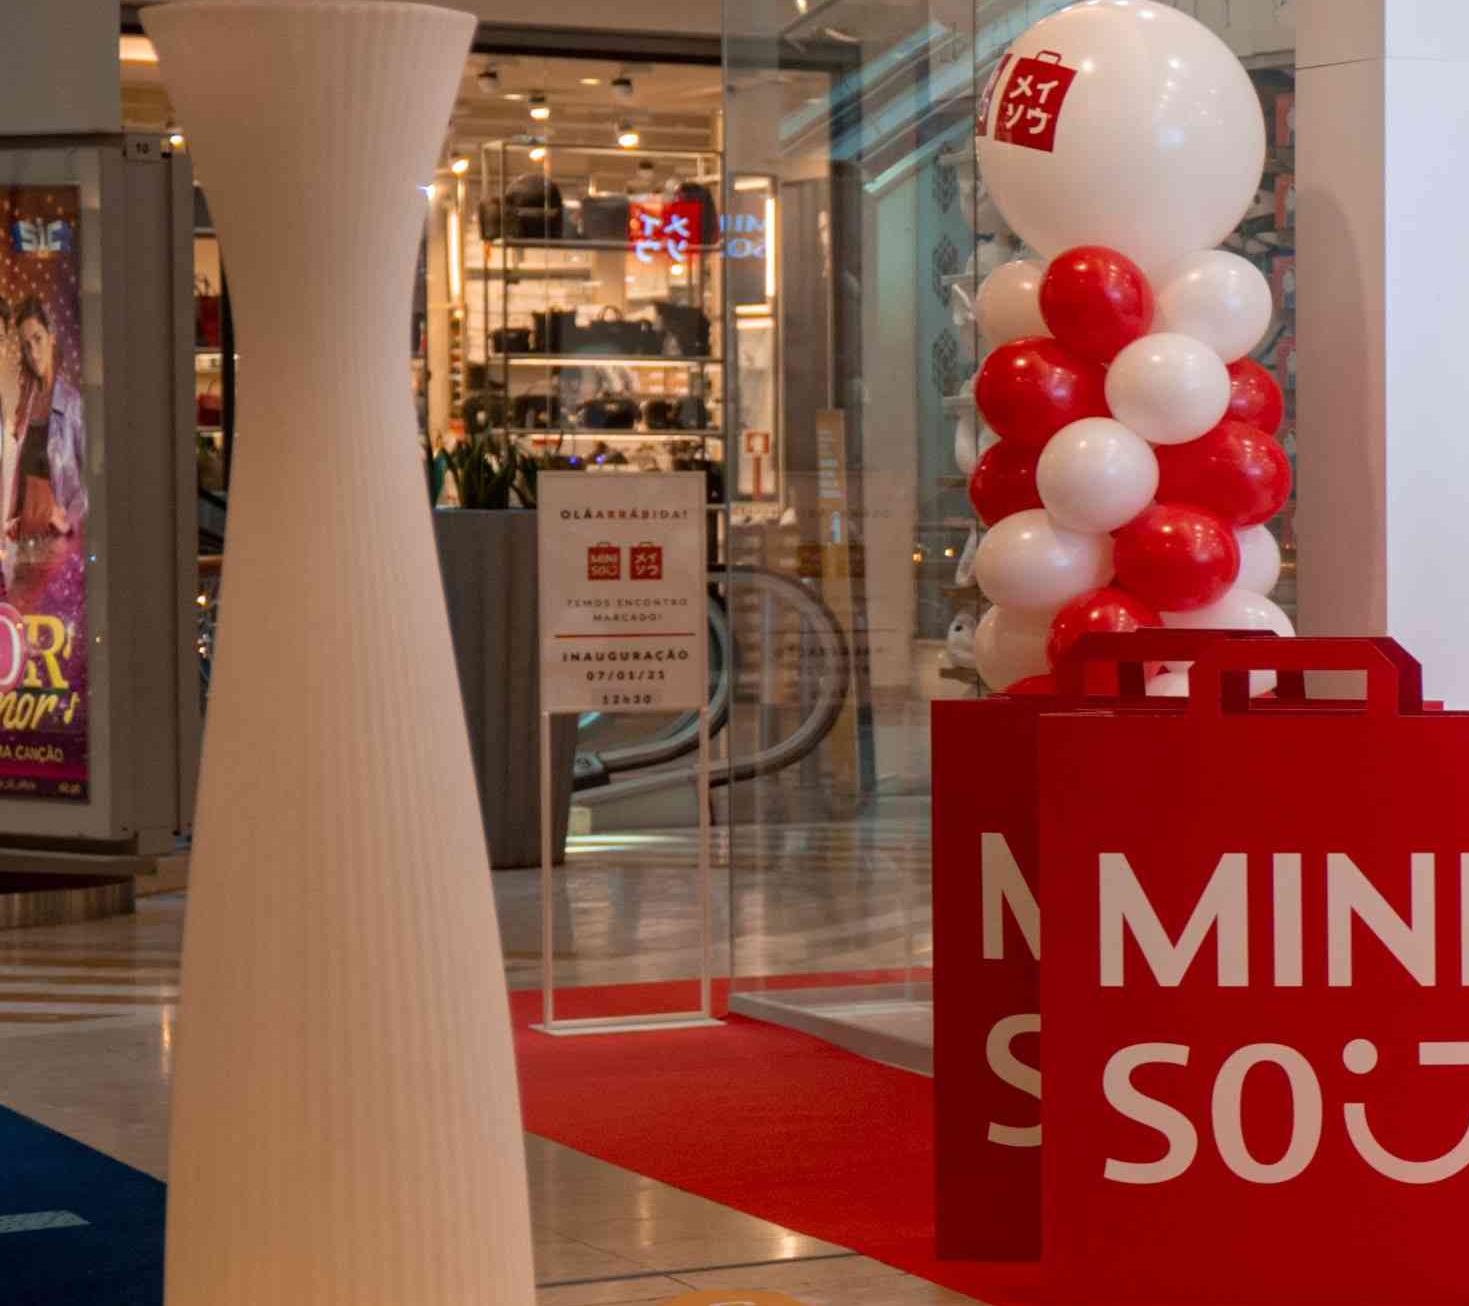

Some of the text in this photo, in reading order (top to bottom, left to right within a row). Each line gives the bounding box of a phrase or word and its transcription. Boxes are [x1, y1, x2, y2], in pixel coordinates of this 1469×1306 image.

[1008, 74, 1059, 105] メイ
[1005, 103, 1049, 135] ソウ
[16, 217, 64, 252] SIC
[617, 597, 688, 607] ENCONTRO
[562, 648, 689, 663] INAUGURAÇÃO
[15, 744, 64, 762] CANÇÃO
